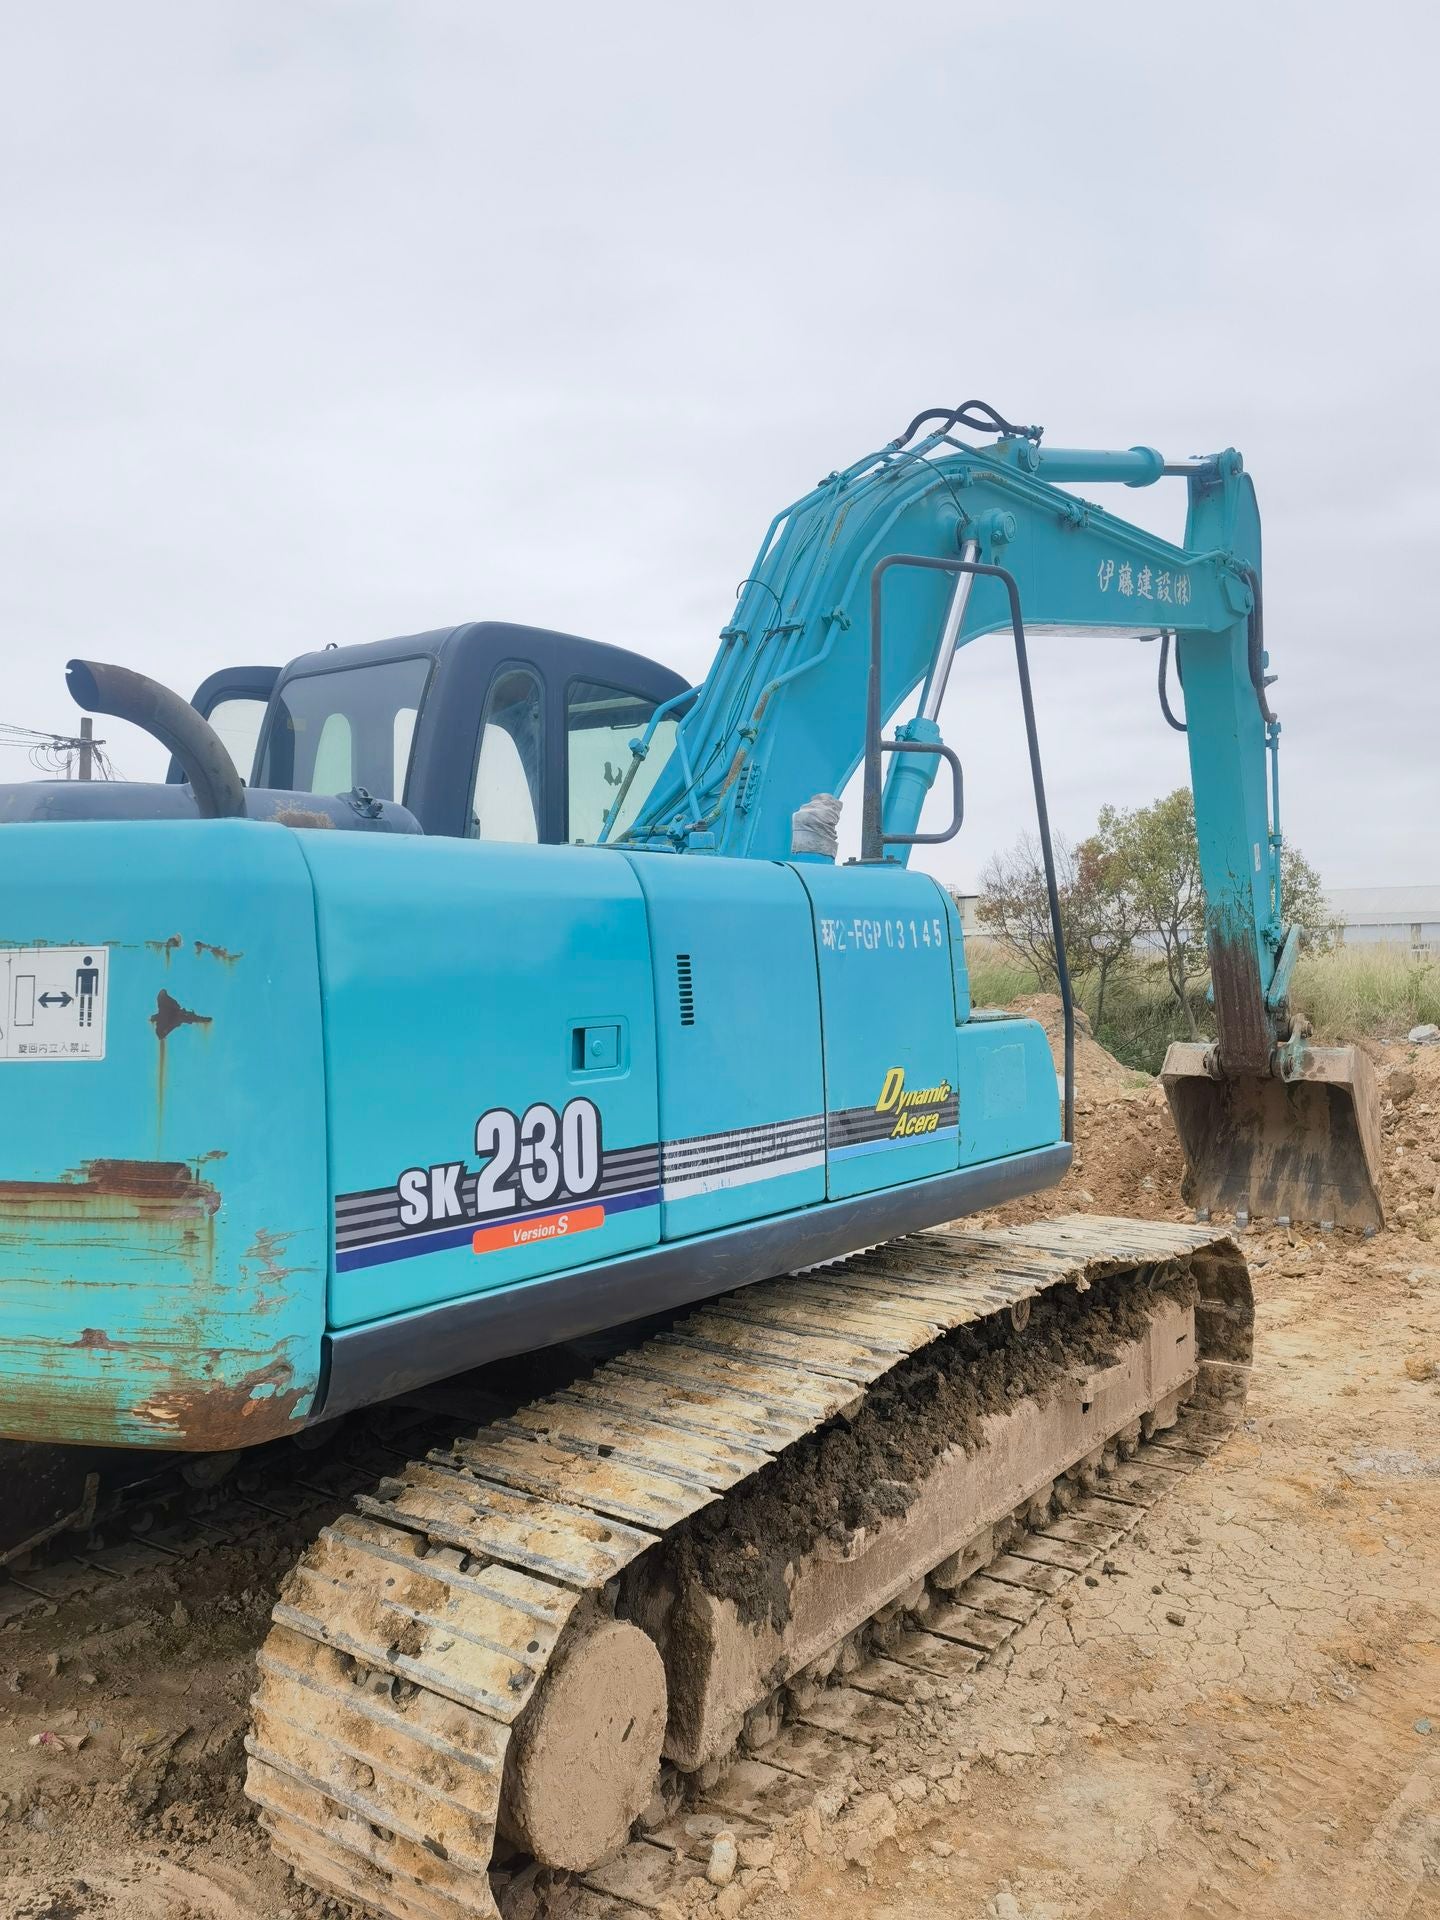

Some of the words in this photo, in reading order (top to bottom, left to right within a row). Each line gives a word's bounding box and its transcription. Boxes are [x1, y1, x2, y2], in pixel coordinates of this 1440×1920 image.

[875, 1066, 952, 1114] Dynamic
[890, 1111, 940, 1139] Acera
[513, 1224, 556, 1243] Version
[557, 1215, 569, 1235] S
